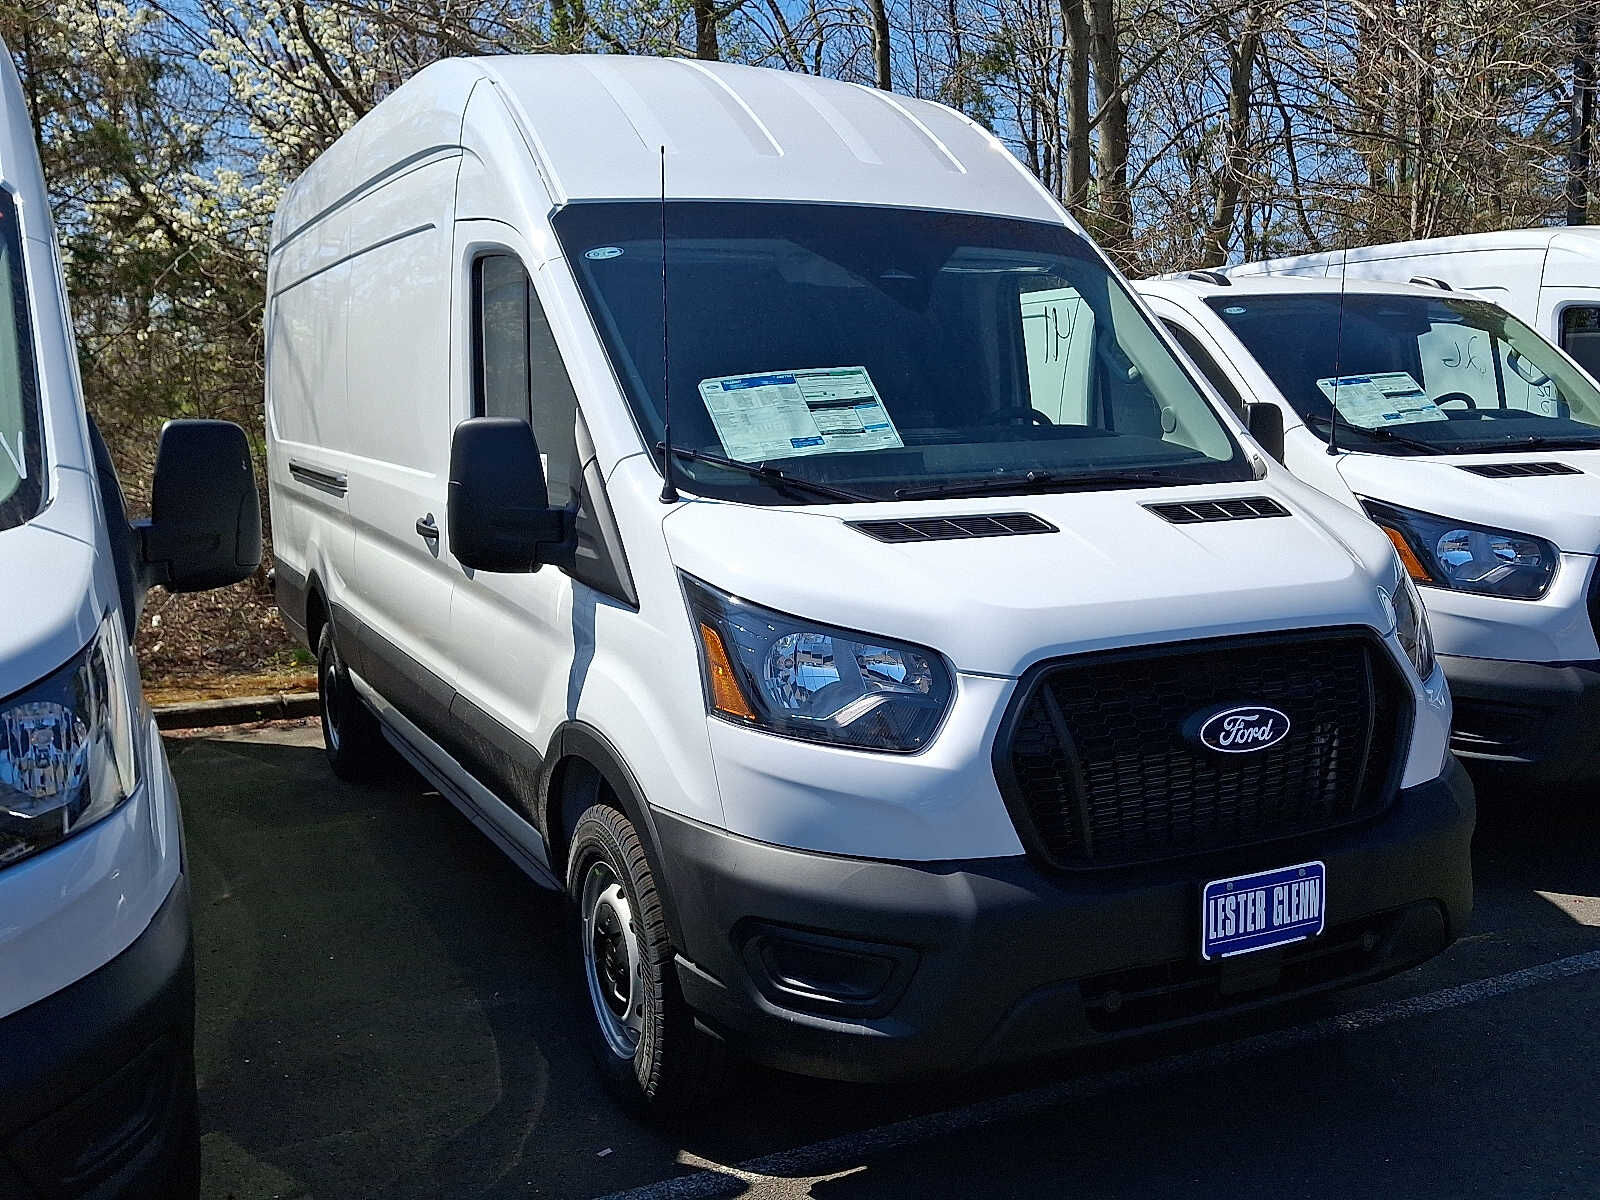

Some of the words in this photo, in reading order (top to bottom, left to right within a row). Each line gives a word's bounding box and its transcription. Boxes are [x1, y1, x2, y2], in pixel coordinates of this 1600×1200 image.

[1219, 714, 1274, 746] Ford
[1208, 890, 1266, 940] LESTER
[1272, 878, 1320, 926] GLENN
